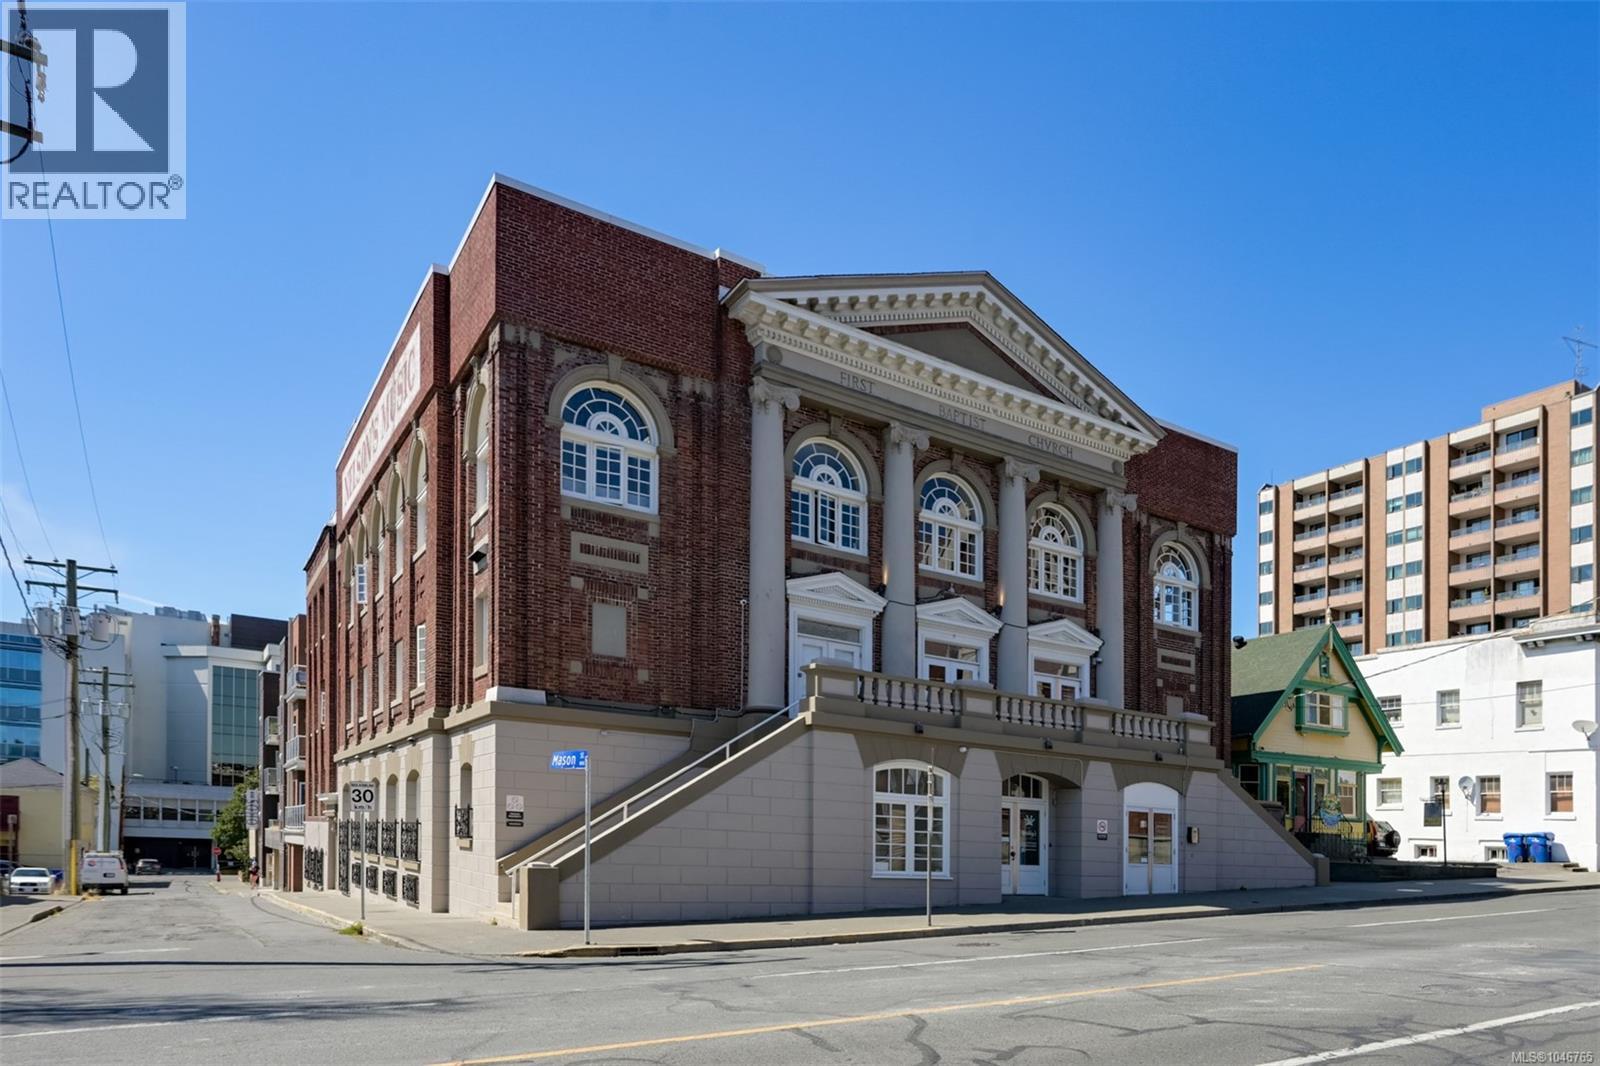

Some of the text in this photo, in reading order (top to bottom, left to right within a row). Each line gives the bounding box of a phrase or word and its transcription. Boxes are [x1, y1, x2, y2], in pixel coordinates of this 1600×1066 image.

[380, 346, 416, 435] MUSIC
[840, 371, 875, 394] FIRST
[938, 404, 987, 431] BAPTIST
[551, 754, 577, 766] Mason
[351, 788, 374, 803] 30
